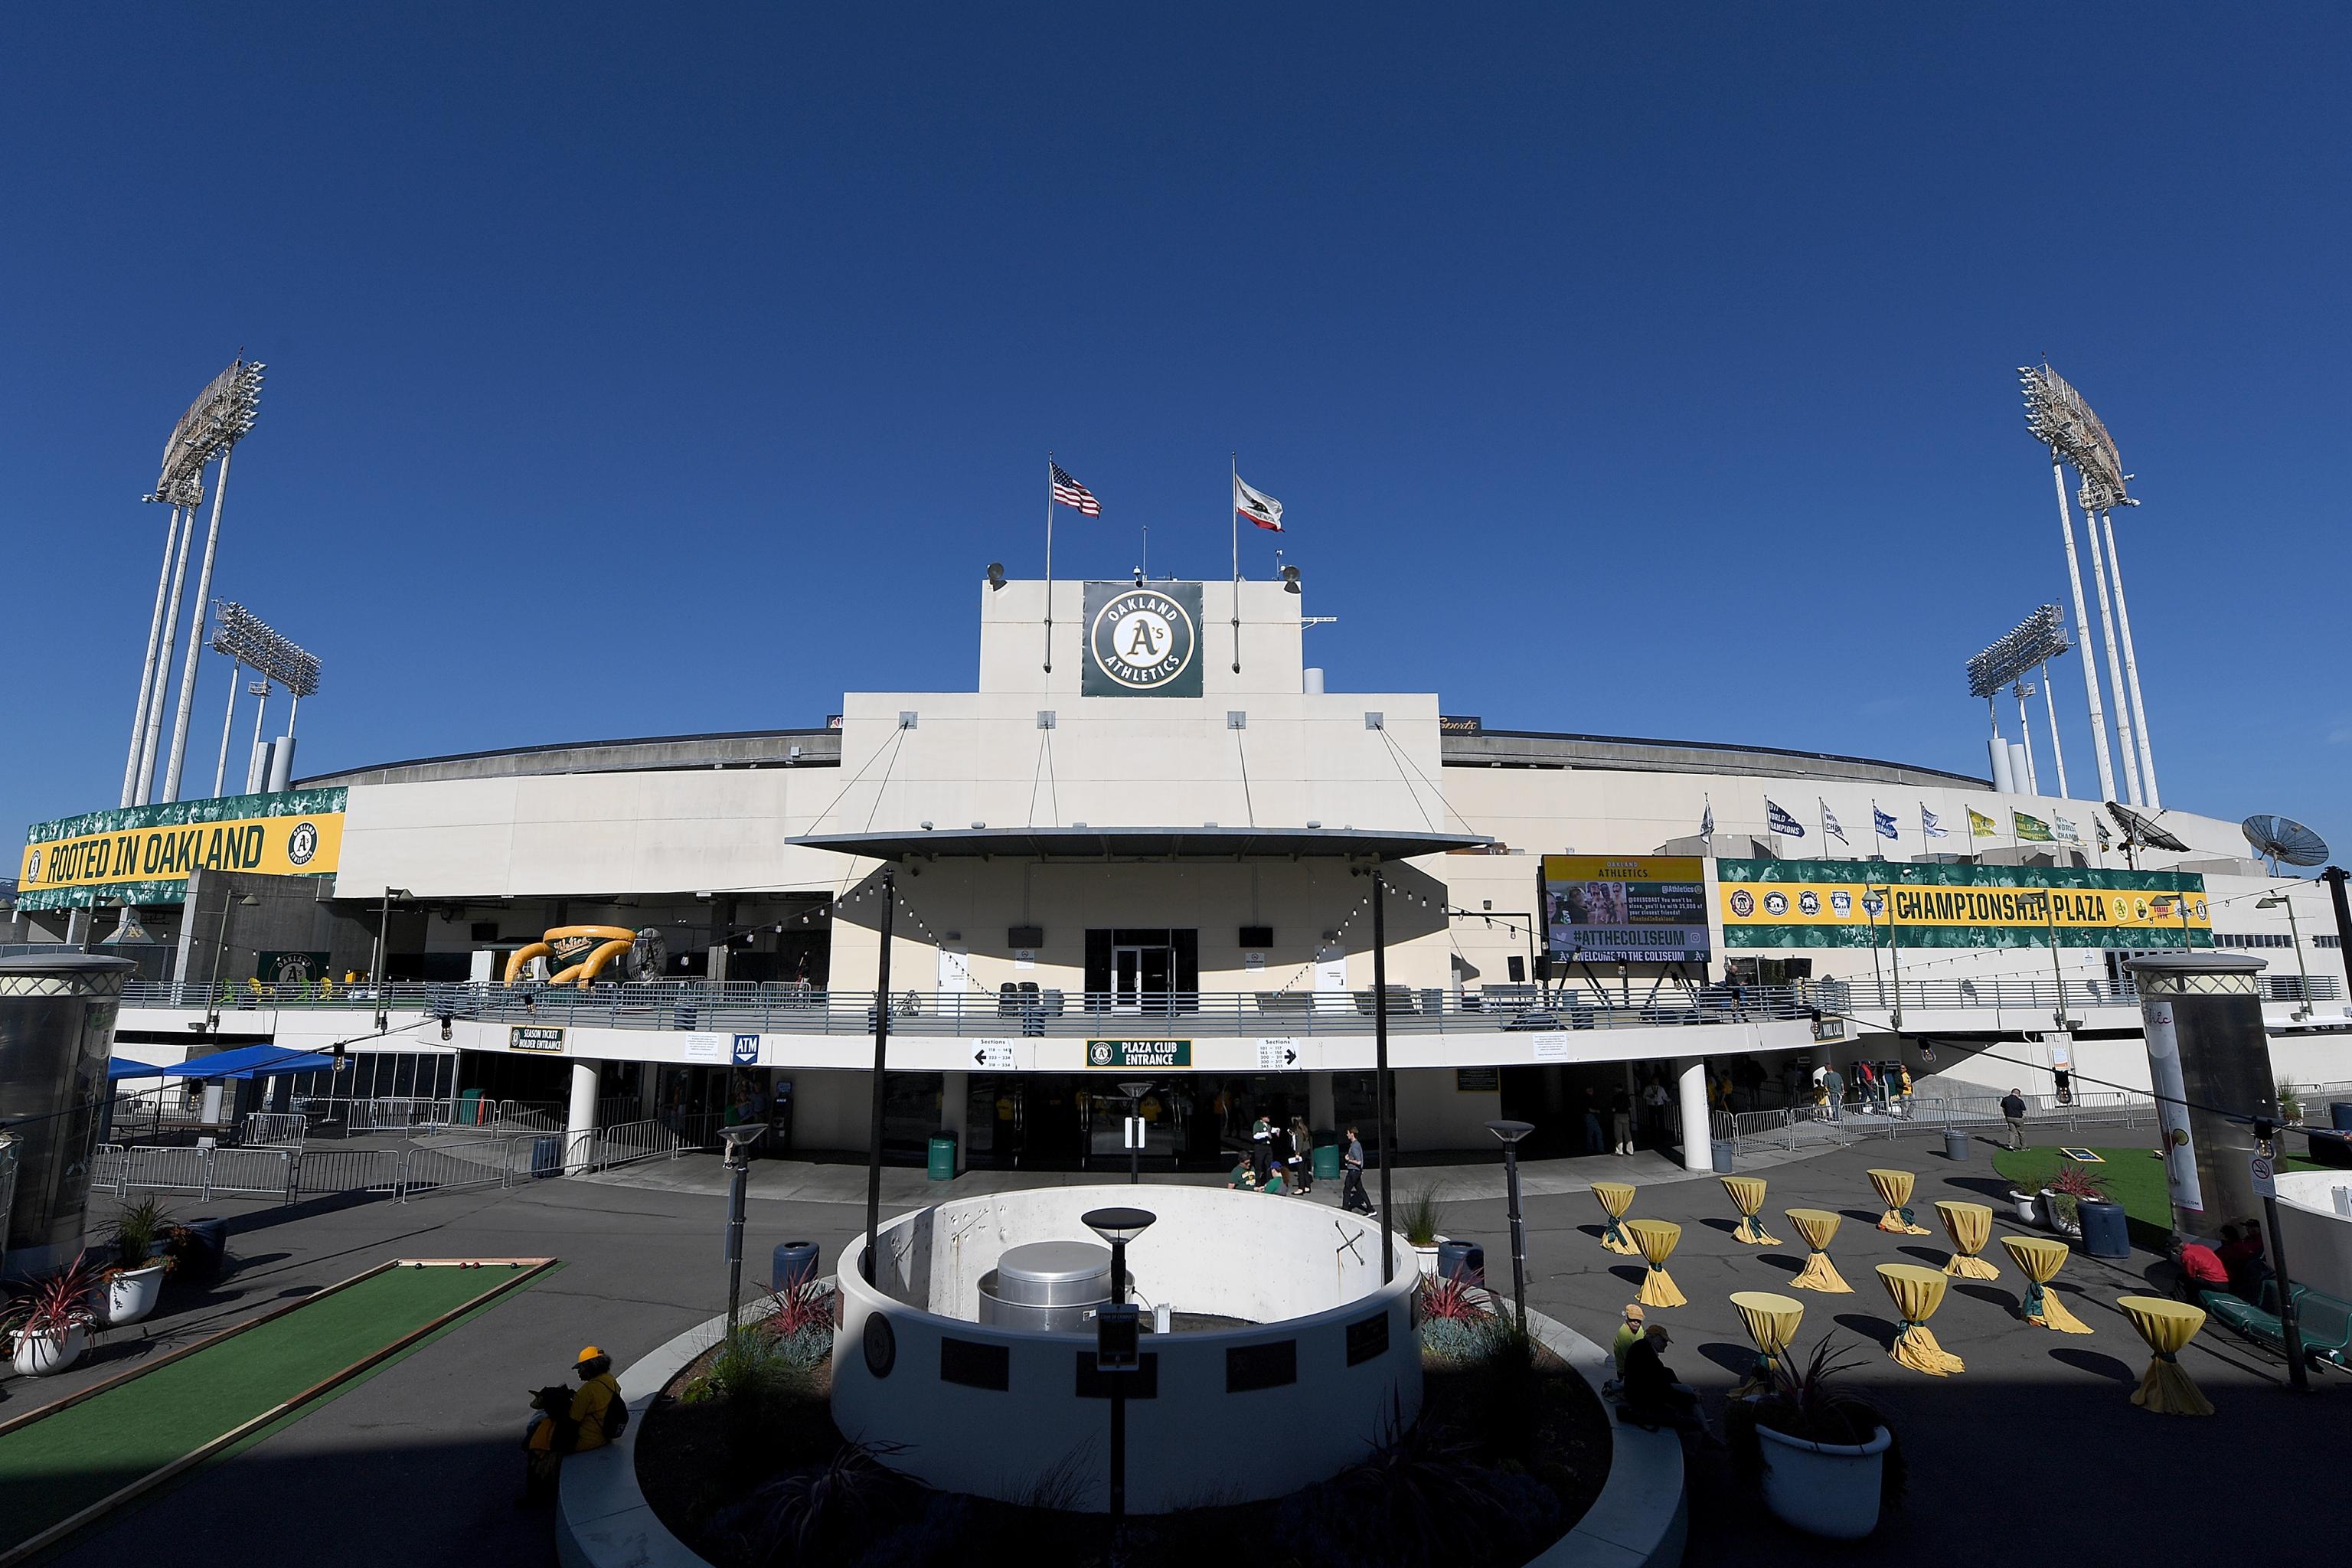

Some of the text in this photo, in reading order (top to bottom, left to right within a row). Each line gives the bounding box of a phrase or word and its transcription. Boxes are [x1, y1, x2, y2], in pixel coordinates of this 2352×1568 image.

[1108, 597, 1178, 622] OAKLAND
[1125, 619, 1164, 656] A's
[1105, 655, 1180, 681] ATHLETICS
[47, 838, 111, 883] ROOTED
[112, 835, 140, 877] IN
[143, 825, 265, 874] OAKLAND
[1599, 869, 1648, 877] ATHLETICS
[1896, 891, 2048, 921] CHAMPIONSHIP
[2053, 894, 2107, 922] PLAZA
[1573, 930, 1685, 946] #ATTHECOLISEUM
[1628, 951, 1644, 962] THE
[1645, 951, 1685, 962] COLISEUM
[524, 1028, 559, 1039] SEASON TICKET
[1822, 1022, 1843, 1037] WILL CALL
[518, 1039, 562, 1050] HOLDER ENTRANCE
[736, 1037, 758, 1053] ATM
[1122, 1042, 1178, 1053] PLAZA CLUB
[1125, 1054, 1173, 1065] ENTRANCE
